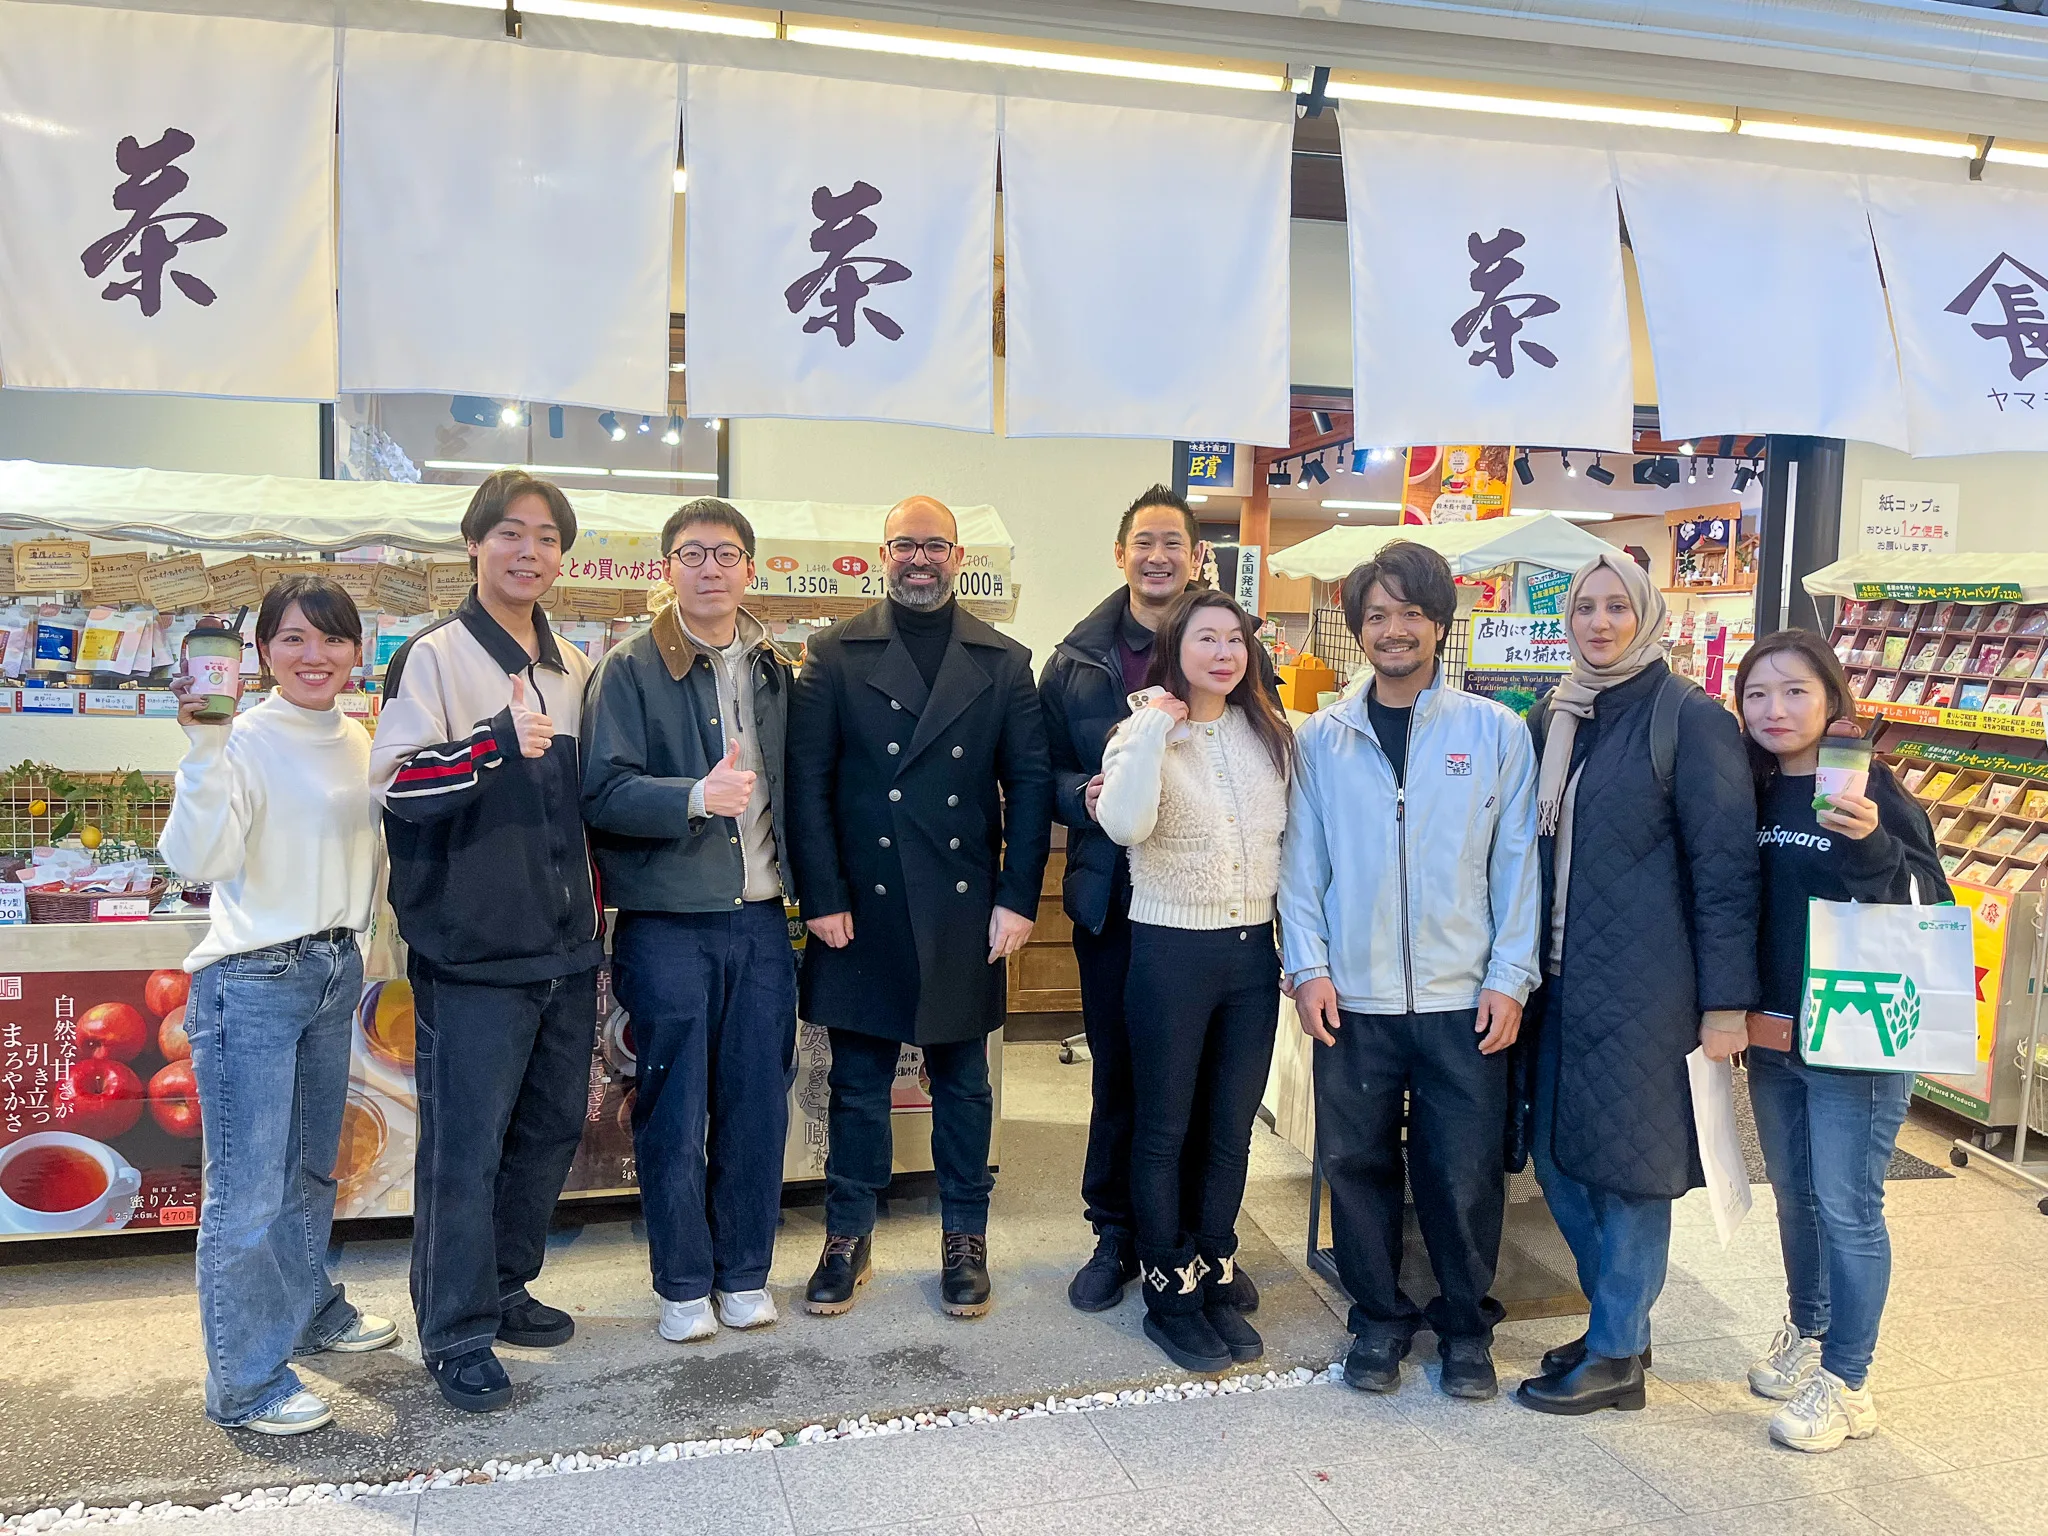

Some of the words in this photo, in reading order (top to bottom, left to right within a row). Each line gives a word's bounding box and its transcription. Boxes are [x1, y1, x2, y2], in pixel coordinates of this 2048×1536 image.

[80, 127, 228, 317] 茶
[784, 180, 912, 348] 茶
[1452, 228, 1561, 379] 茶
[1987, 387, 2048, 412] ヤマ
[1189, 444, 1227, 453] 木長十商店
[1878, 494, 1941, 513] 紙コップは
[786, 576, 838, 595] 1,350円
[1468, 674, 1509, 684] Captivating
[1510, 674, 1521, 683] the
[1522, 674, 1543, 683] World
[1474, 684, 1508, 692] Tradition
[1509, 684, 1517, 692] of
[1517, 685, 1537, 693] Japan
[50, 994, 78, 1119] 自然な甘さが
[1, 1022, 25, 1133] まろやかさ
[25, 1042, 50, 1124] 引き立つ
[1924, 1082, 1949, 1098] Featured
[1950, 1093, 1977, 1109] Products
[130, 1192, 197, 1209] 蜜りんご
